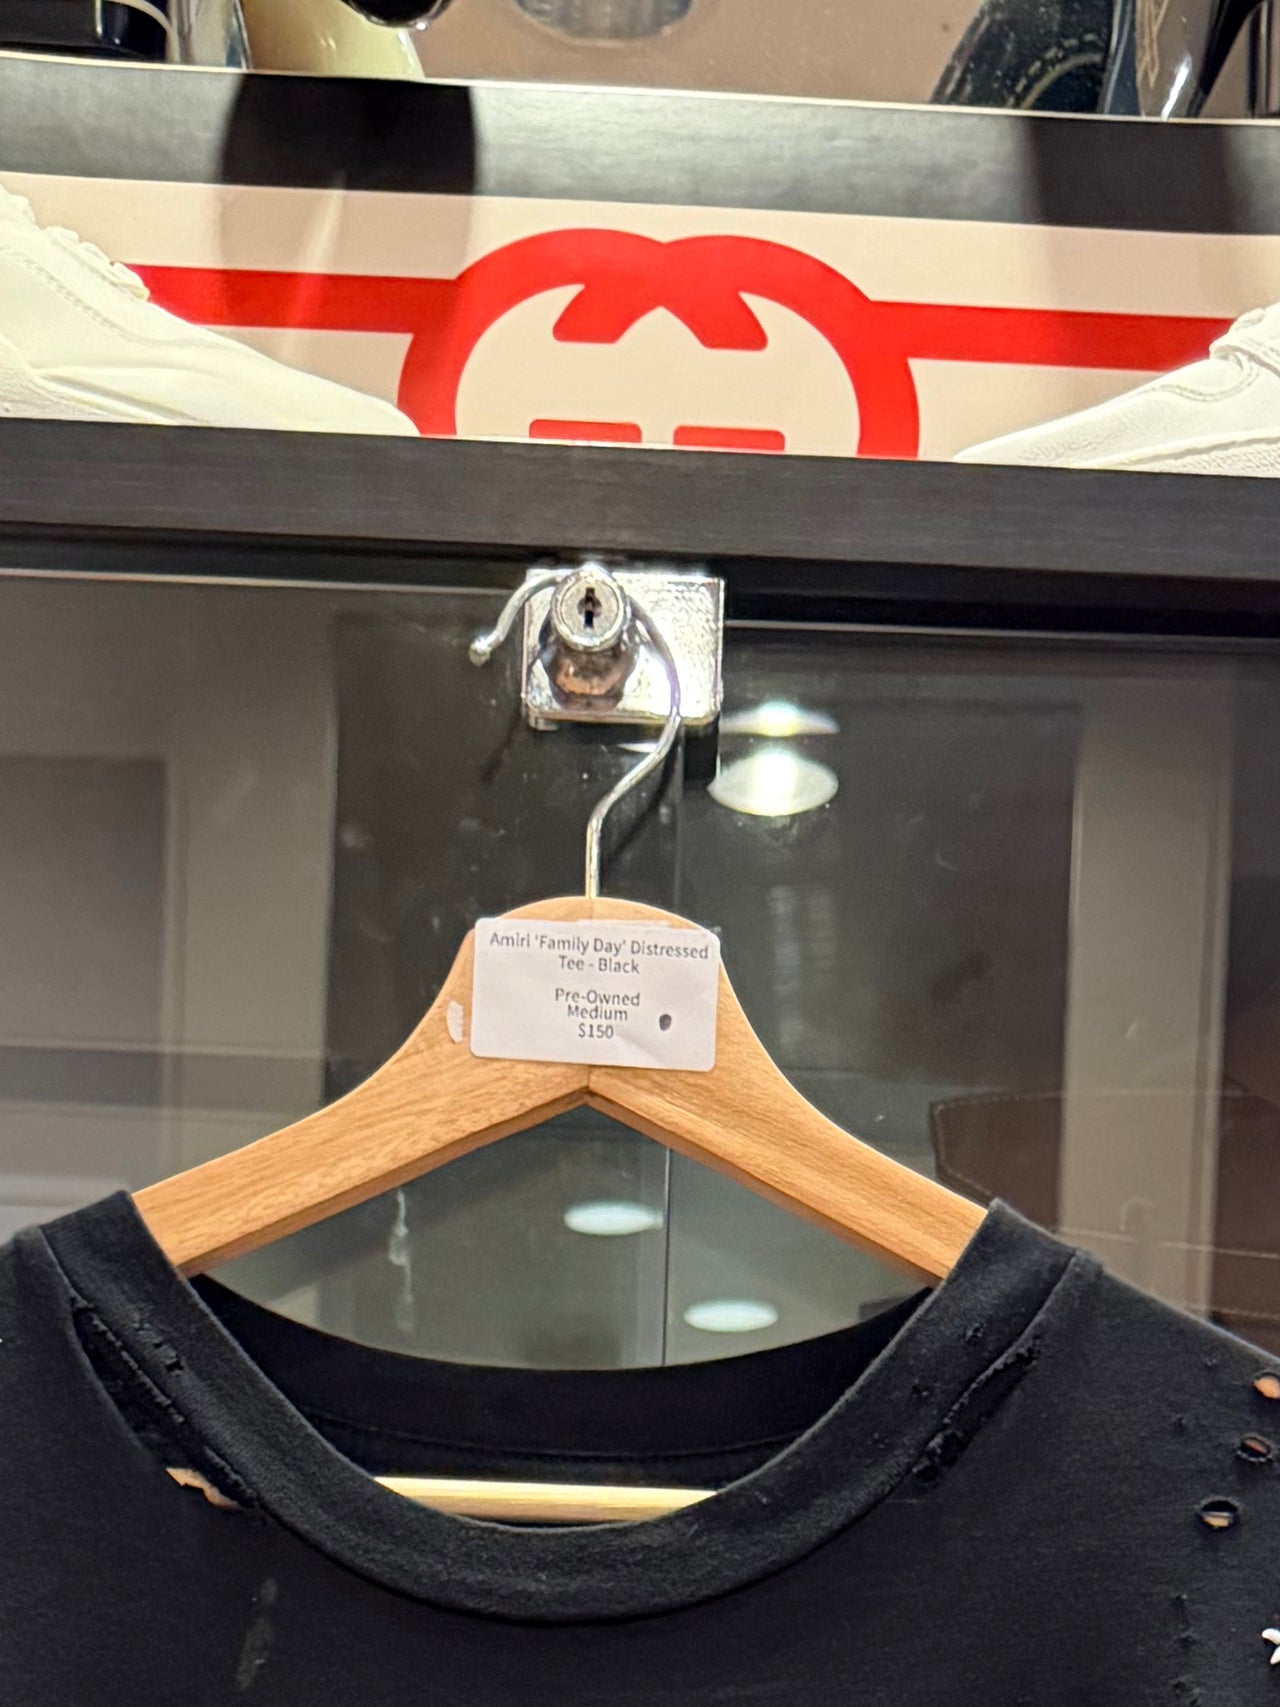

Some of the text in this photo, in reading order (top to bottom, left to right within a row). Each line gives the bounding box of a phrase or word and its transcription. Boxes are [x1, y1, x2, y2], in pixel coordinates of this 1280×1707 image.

[490, 932, 531, 948] Amiri
[631, 940, 709, 960] Distressed
[559, 955, 585, 971] Tee
[599, 957, 640, 974] Black
[555, 987, 640, 1006] Pre-Owned
[567, 1004, 628, 1022] Medium
[578, 1023, 614, 1039] $150
